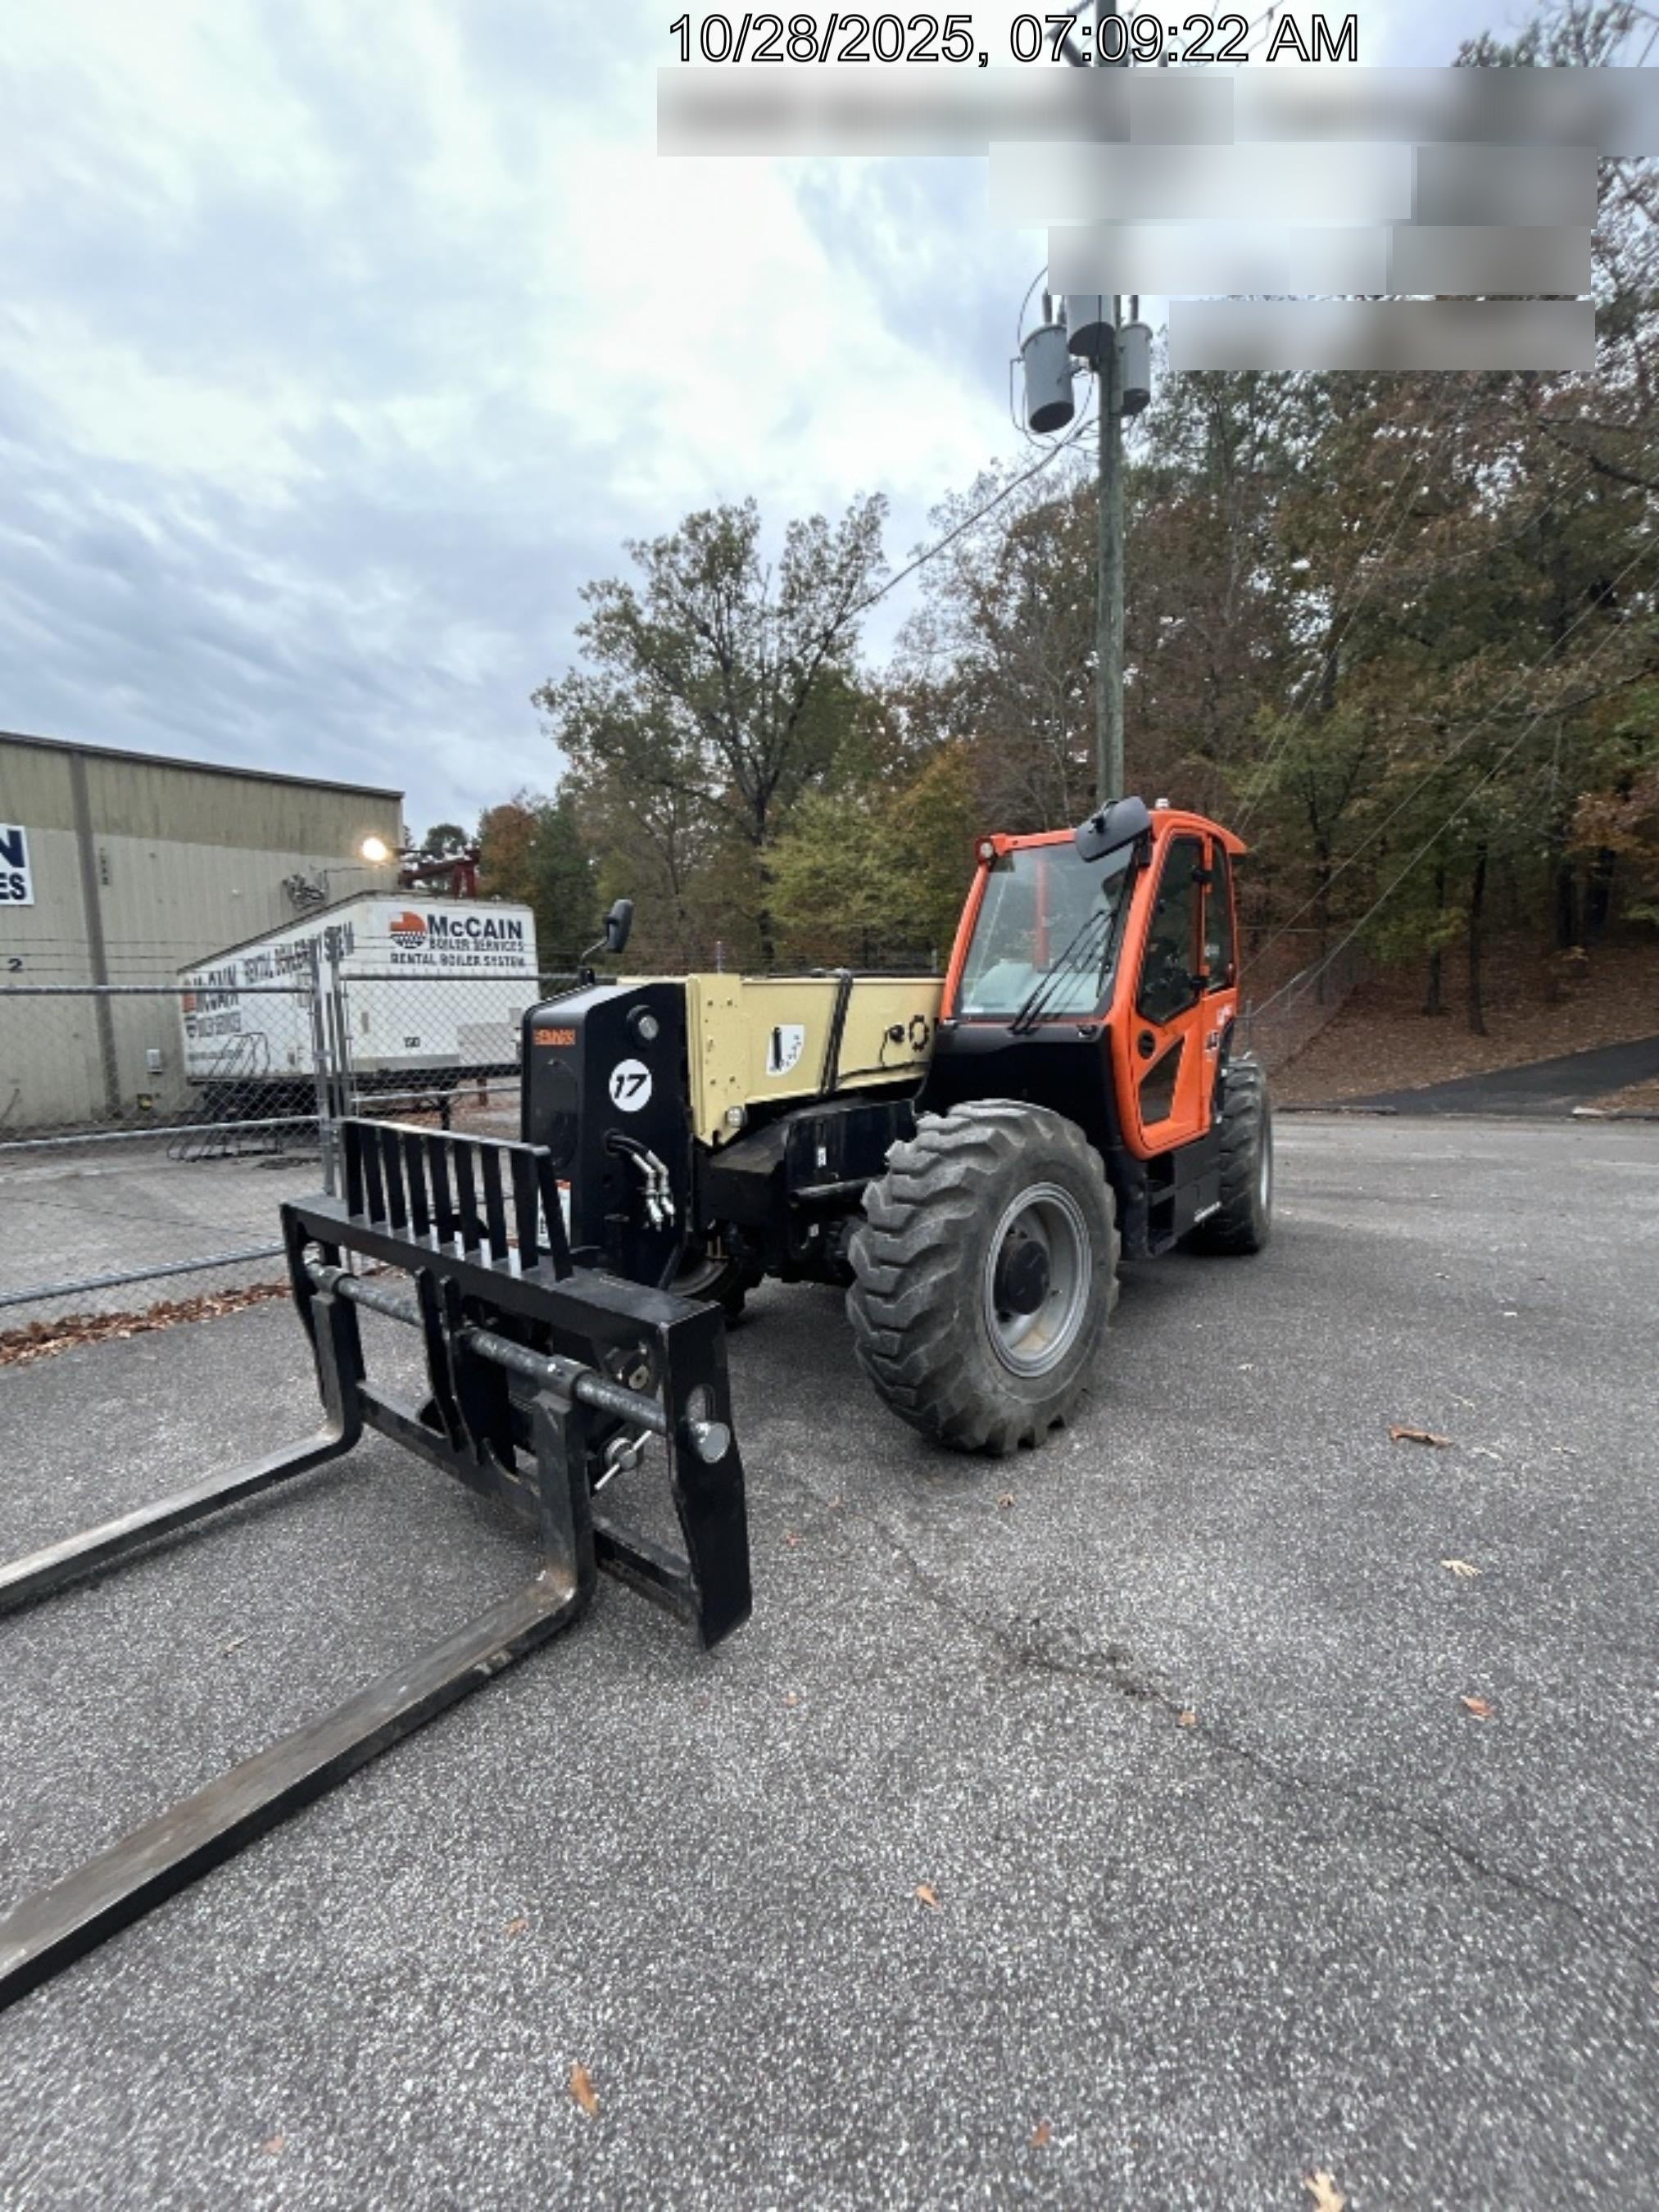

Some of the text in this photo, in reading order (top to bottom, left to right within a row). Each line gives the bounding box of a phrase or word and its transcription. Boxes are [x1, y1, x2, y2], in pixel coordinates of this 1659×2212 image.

[427, 913, 524, 940] McCAIN
[428, 936, 524, 952] BOILER SERVICES
[7, 958, 24, 973] 2
[390, 952, 527, 968] RENTAL BOILER SYSTEM
[614, 1073, 648, 1099] 17
